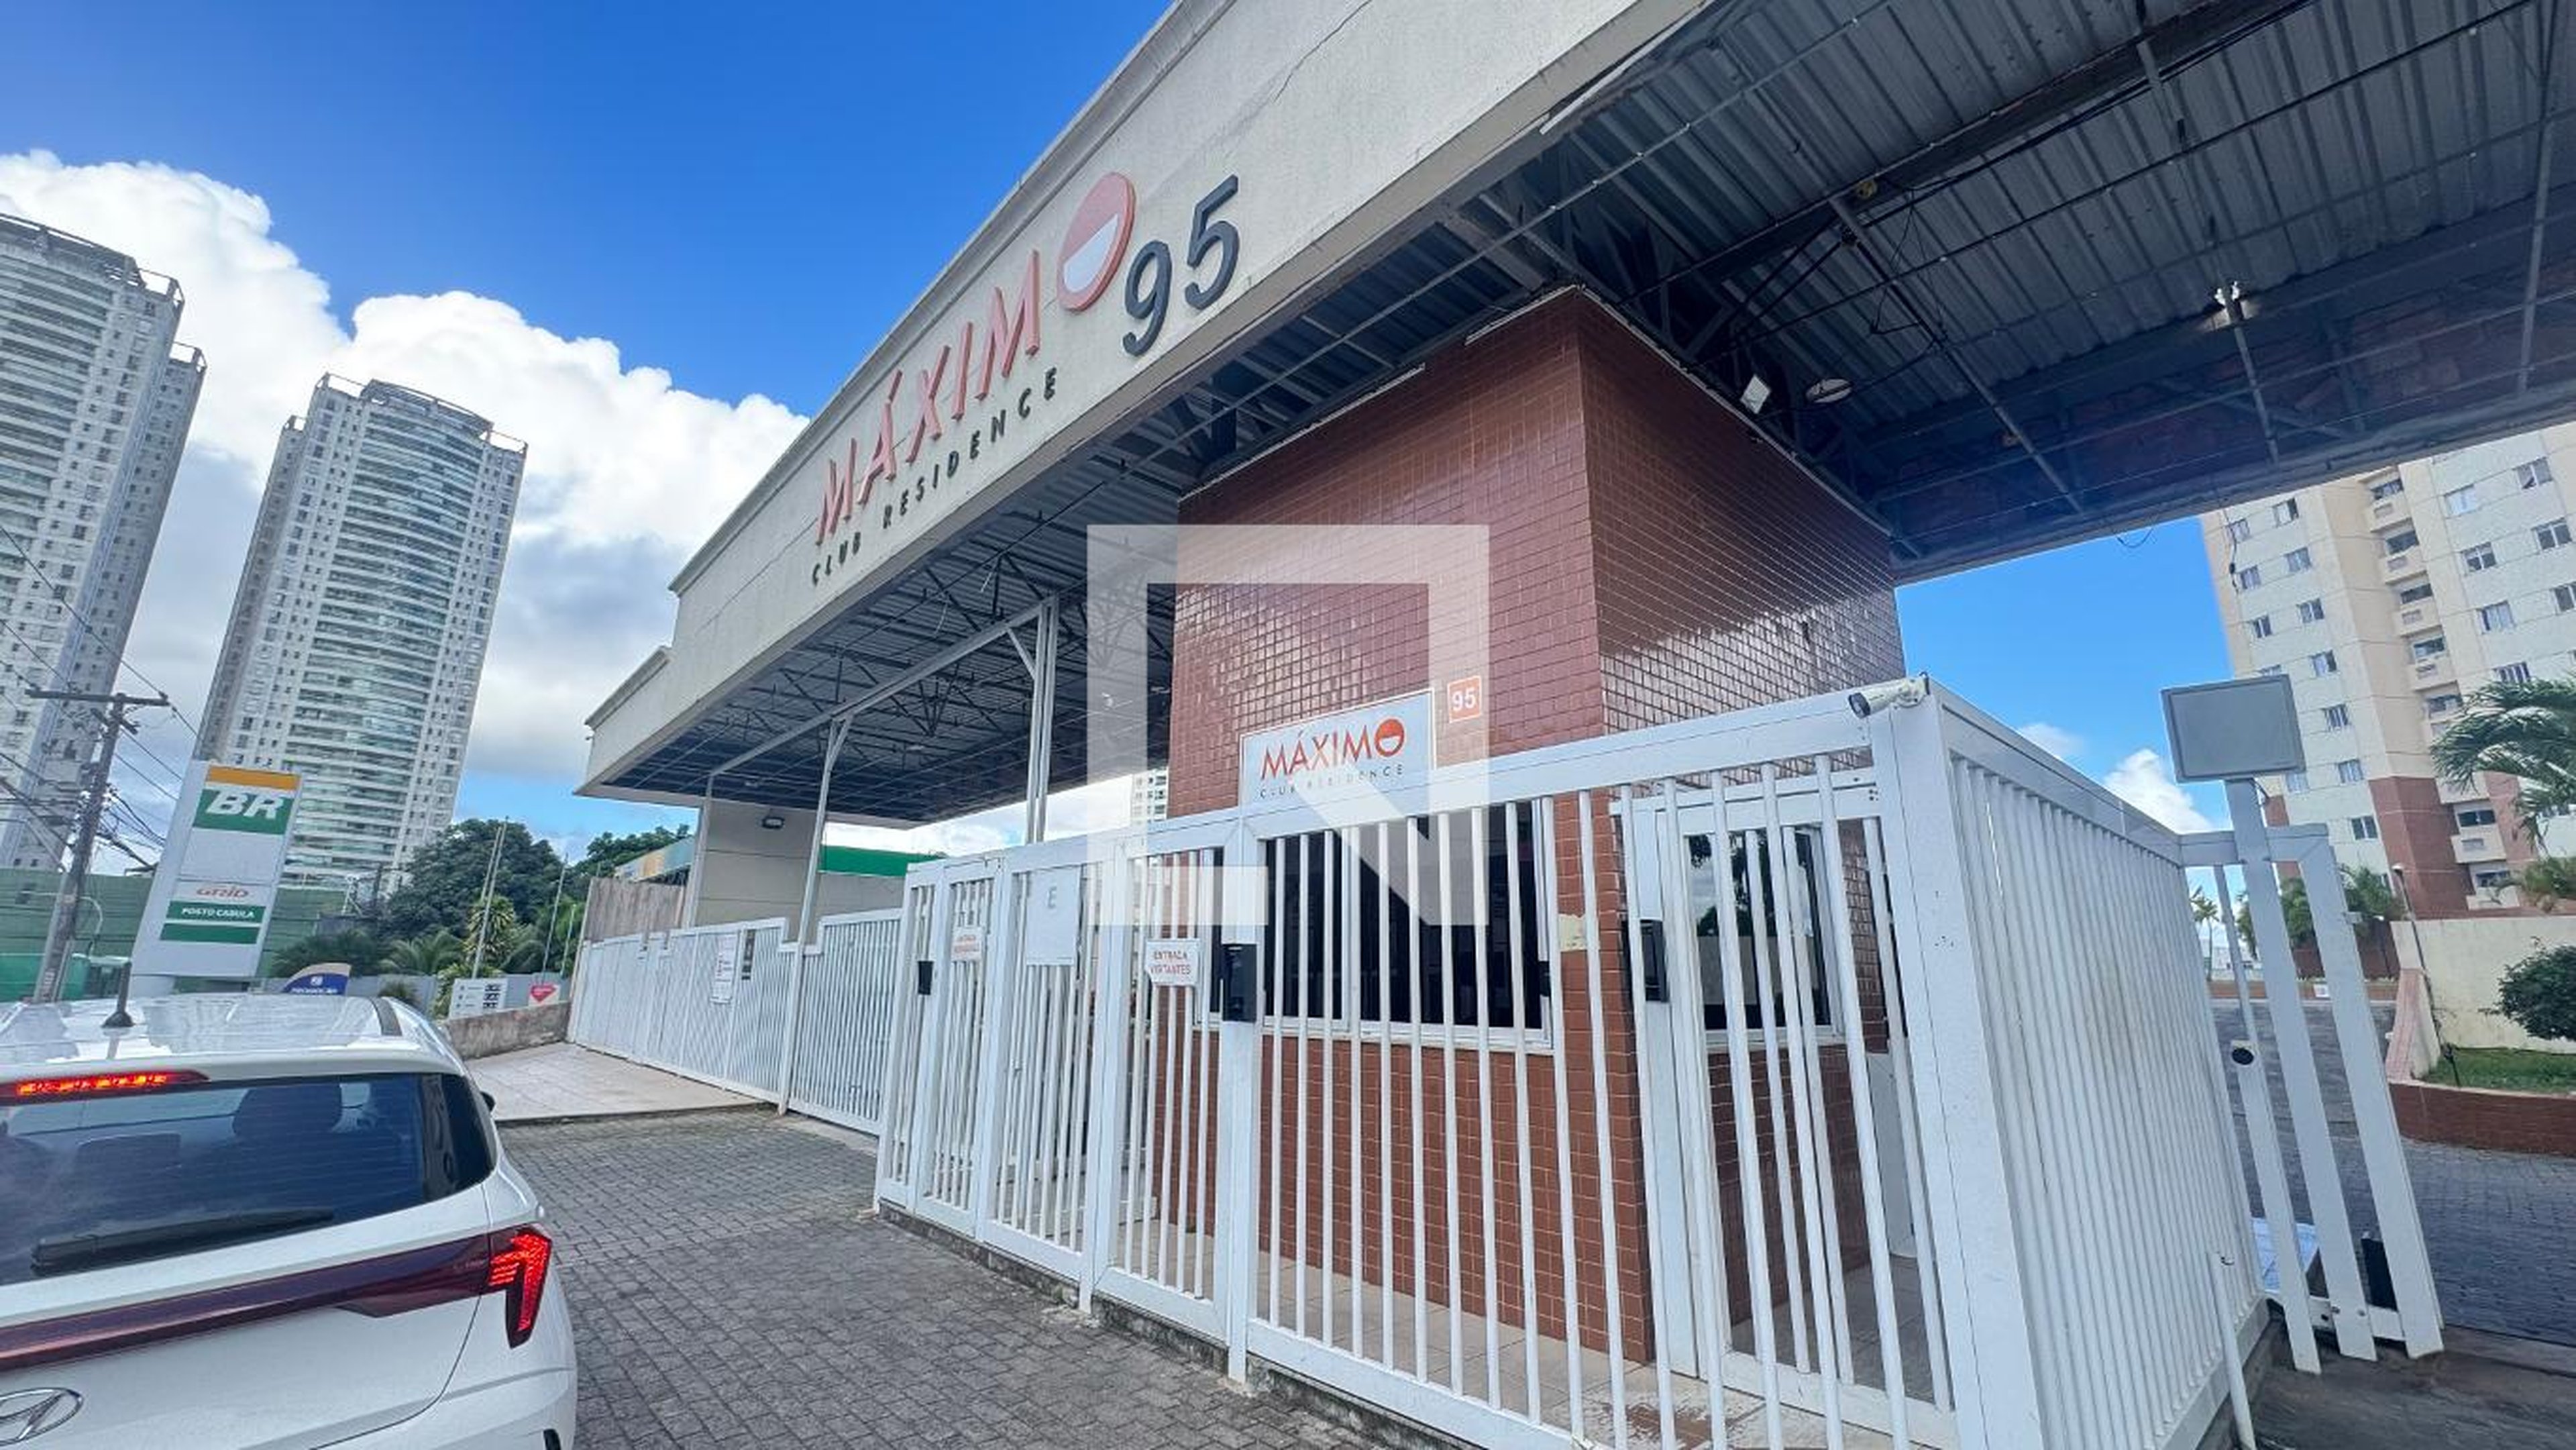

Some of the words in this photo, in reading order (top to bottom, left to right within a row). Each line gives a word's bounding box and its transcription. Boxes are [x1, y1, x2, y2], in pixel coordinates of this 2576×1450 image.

[1122, 174, 1240, 357] 95
[812, 532, 861, 586] CLUB
[883, 367, 1058, 529] RESIDENCE
[1452, 686, 1476, 712] 95
[1260, 718, 1405, 781] MÁXIMO
[205, 789, 284, 820] BR
